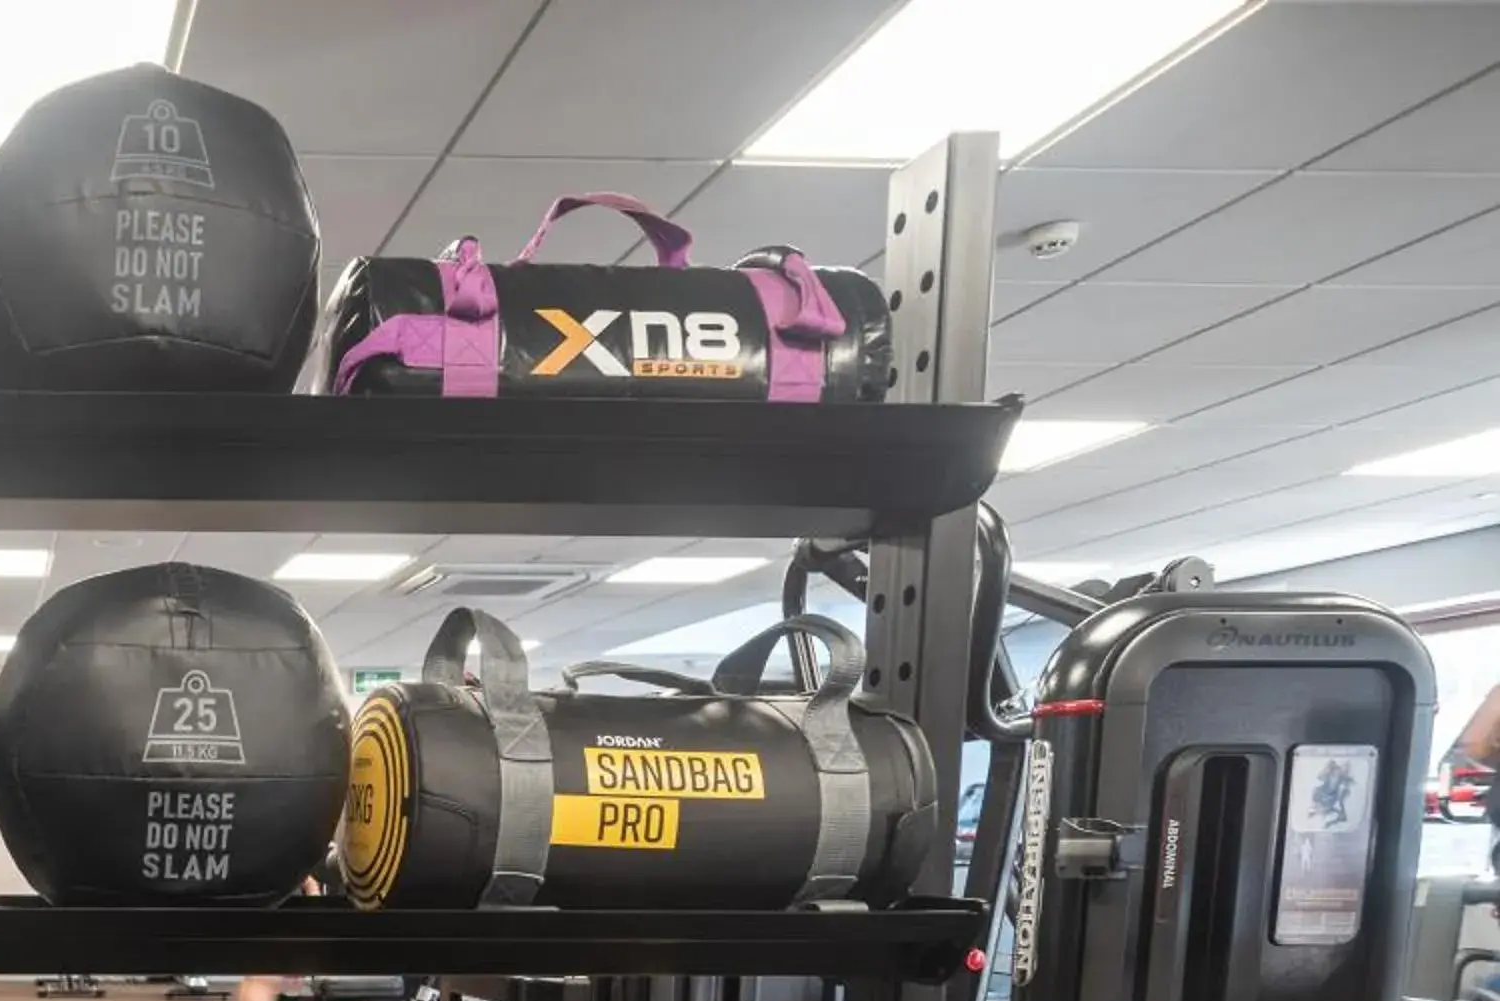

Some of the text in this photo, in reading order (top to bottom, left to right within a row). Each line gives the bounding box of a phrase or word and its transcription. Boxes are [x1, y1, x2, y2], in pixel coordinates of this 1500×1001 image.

[143, 123, 180, 153] 10
[117, 210, 205, 246] PLEASE
[116, 247, 202, 280] DO NOT
[111, 284, 201, 318] SLAM
[641, 363, 737, 376] SPORTS
[1236, 633, 1357, 647] NAUTILUS
[173, 697, 217, 732] 25
[597, 753, 753, 793] SANDBAG
[148, 791, 235, 820] PLEASE
[146, 822, 232, 850] DO NOT
[598, 802, 665, 843] PRO
[142, 853, 230, 880] SLAM
[1162, 819, 1180, 888] ABDOMINAL
